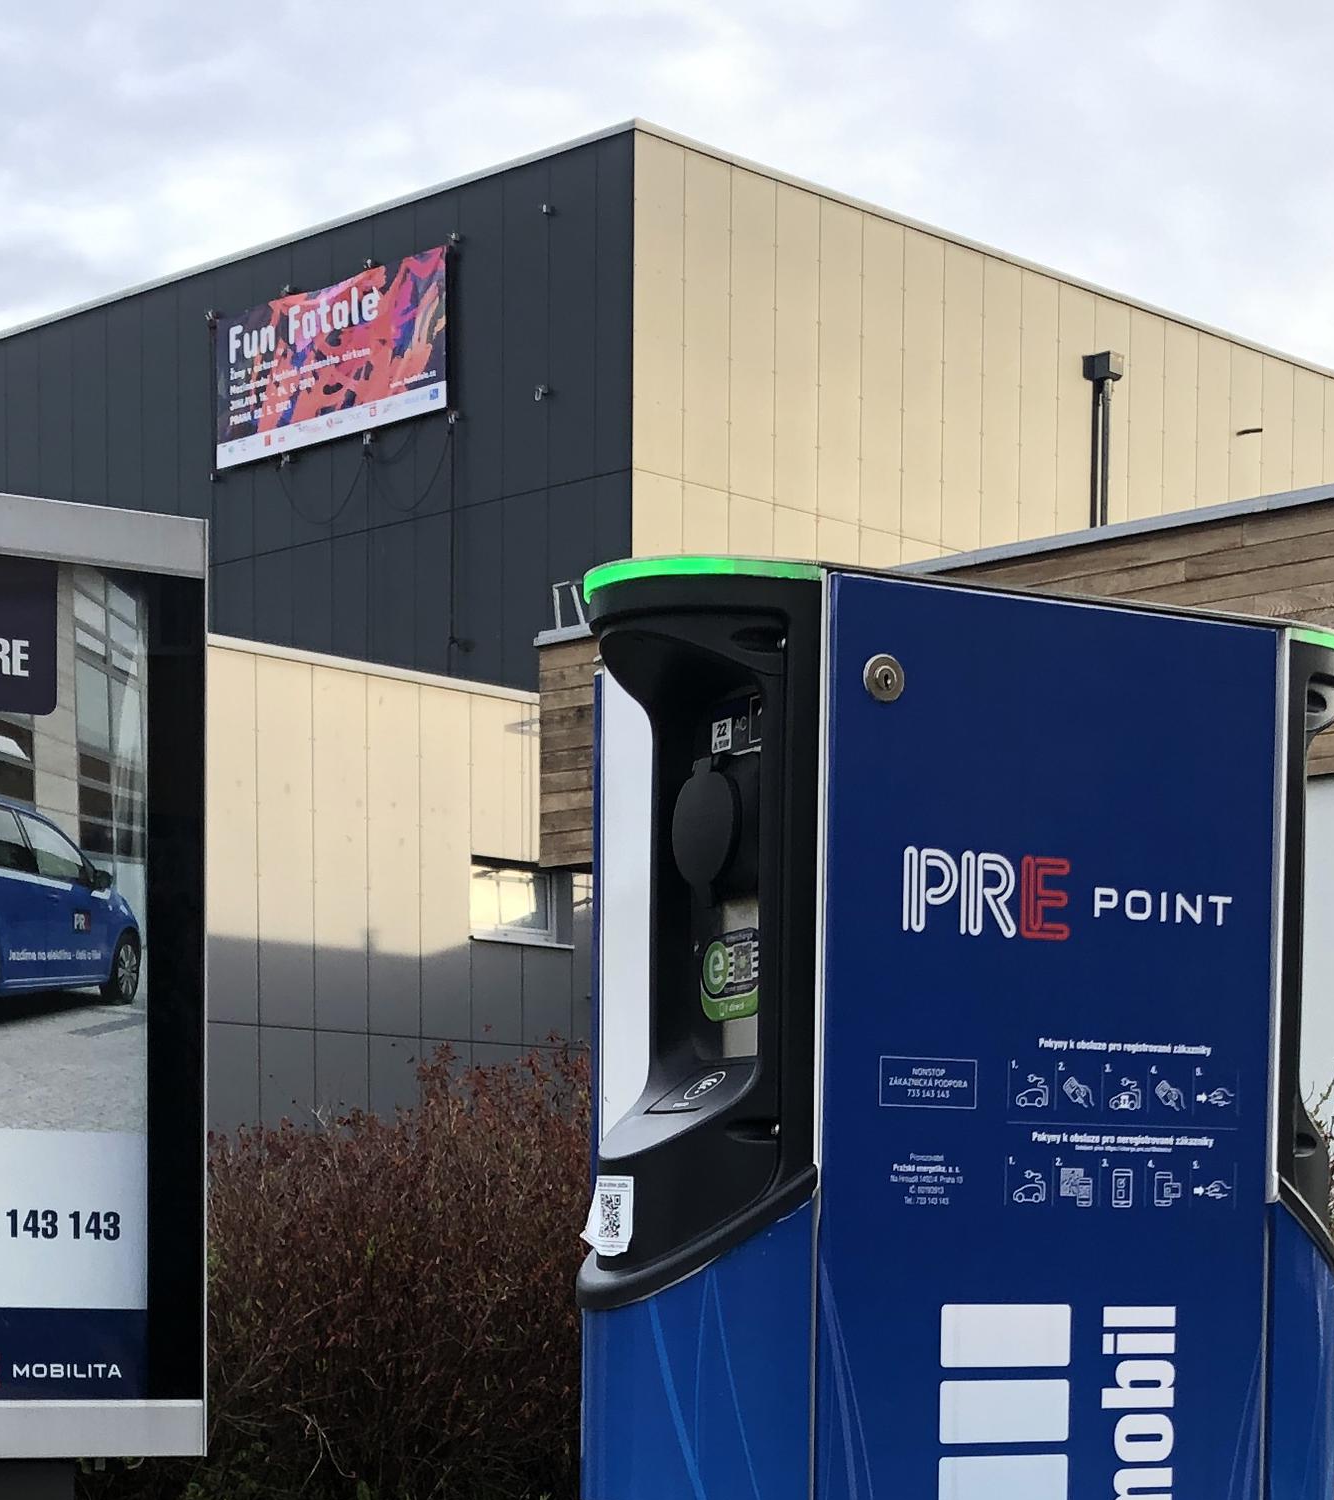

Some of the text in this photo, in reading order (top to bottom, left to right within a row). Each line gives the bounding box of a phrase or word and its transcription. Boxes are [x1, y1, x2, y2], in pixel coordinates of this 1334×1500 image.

[229, 286, 380, 364] Fun Fatale
[902, 845, 1233, 941] PRE POINT
[1108, 1043, 1122, 1053] pro
[1011, 1059, 1019, 1069] 1.
[912, 1067, 946, 1077] NONSTOP
[888, 1076, 968, 1088] ZÁKAZNICKÁ PODPORA
[907, 1089, 920, 1098] 733
[921, 1089, 935, 1098] 143
[1101, 1135, 1115, 1145] pro
[6, 1208, 58, 1239] 143
[69, 1210, 121, 1241] 143
[12, 1363, 122, 1379] MOBILITA
